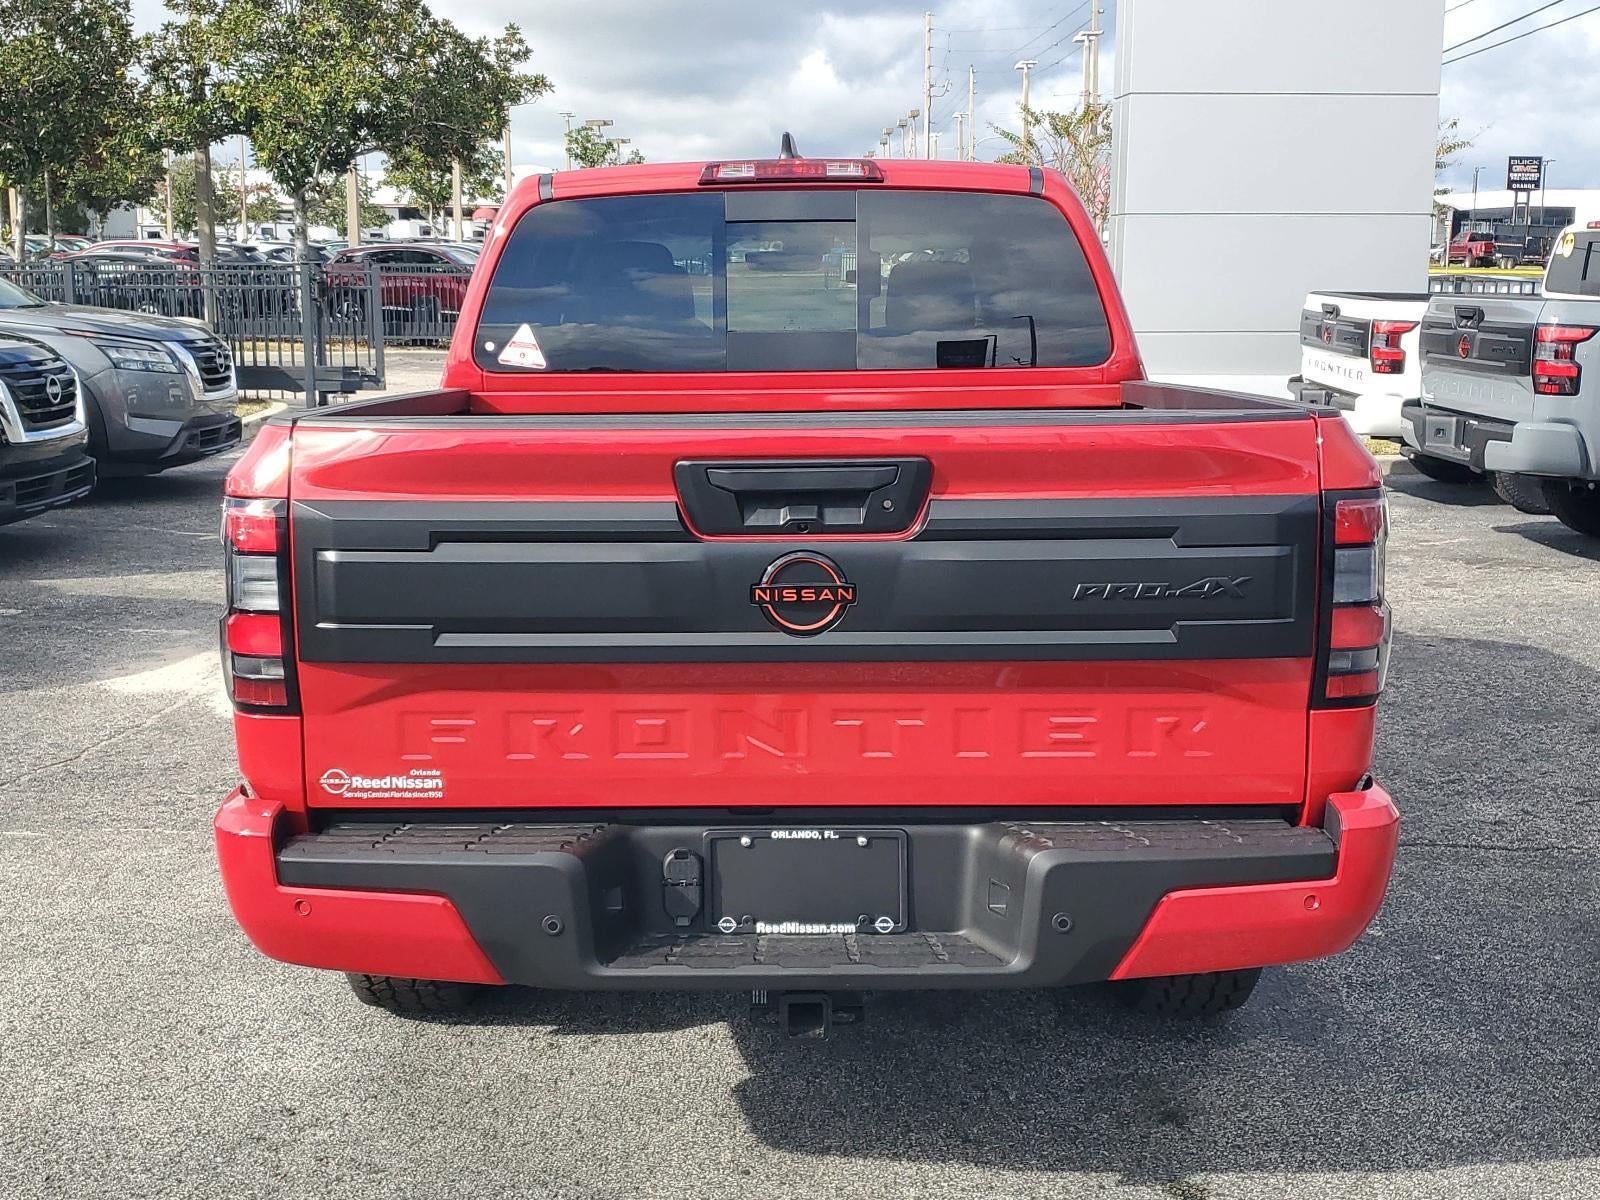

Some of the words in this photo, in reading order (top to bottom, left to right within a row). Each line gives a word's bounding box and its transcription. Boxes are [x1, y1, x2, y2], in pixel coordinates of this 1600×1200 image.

[1308, 358, 1364, 381] FRONTIER
[755, 588, 853, 602] NISSAN
[397, 708, 1213, 760] FRONTIER
[771, 831, 822, 839] ORLANDO,
[824, 831, 839, 839] FL.
[756, 922, 856, 934] ReedNissan.com
